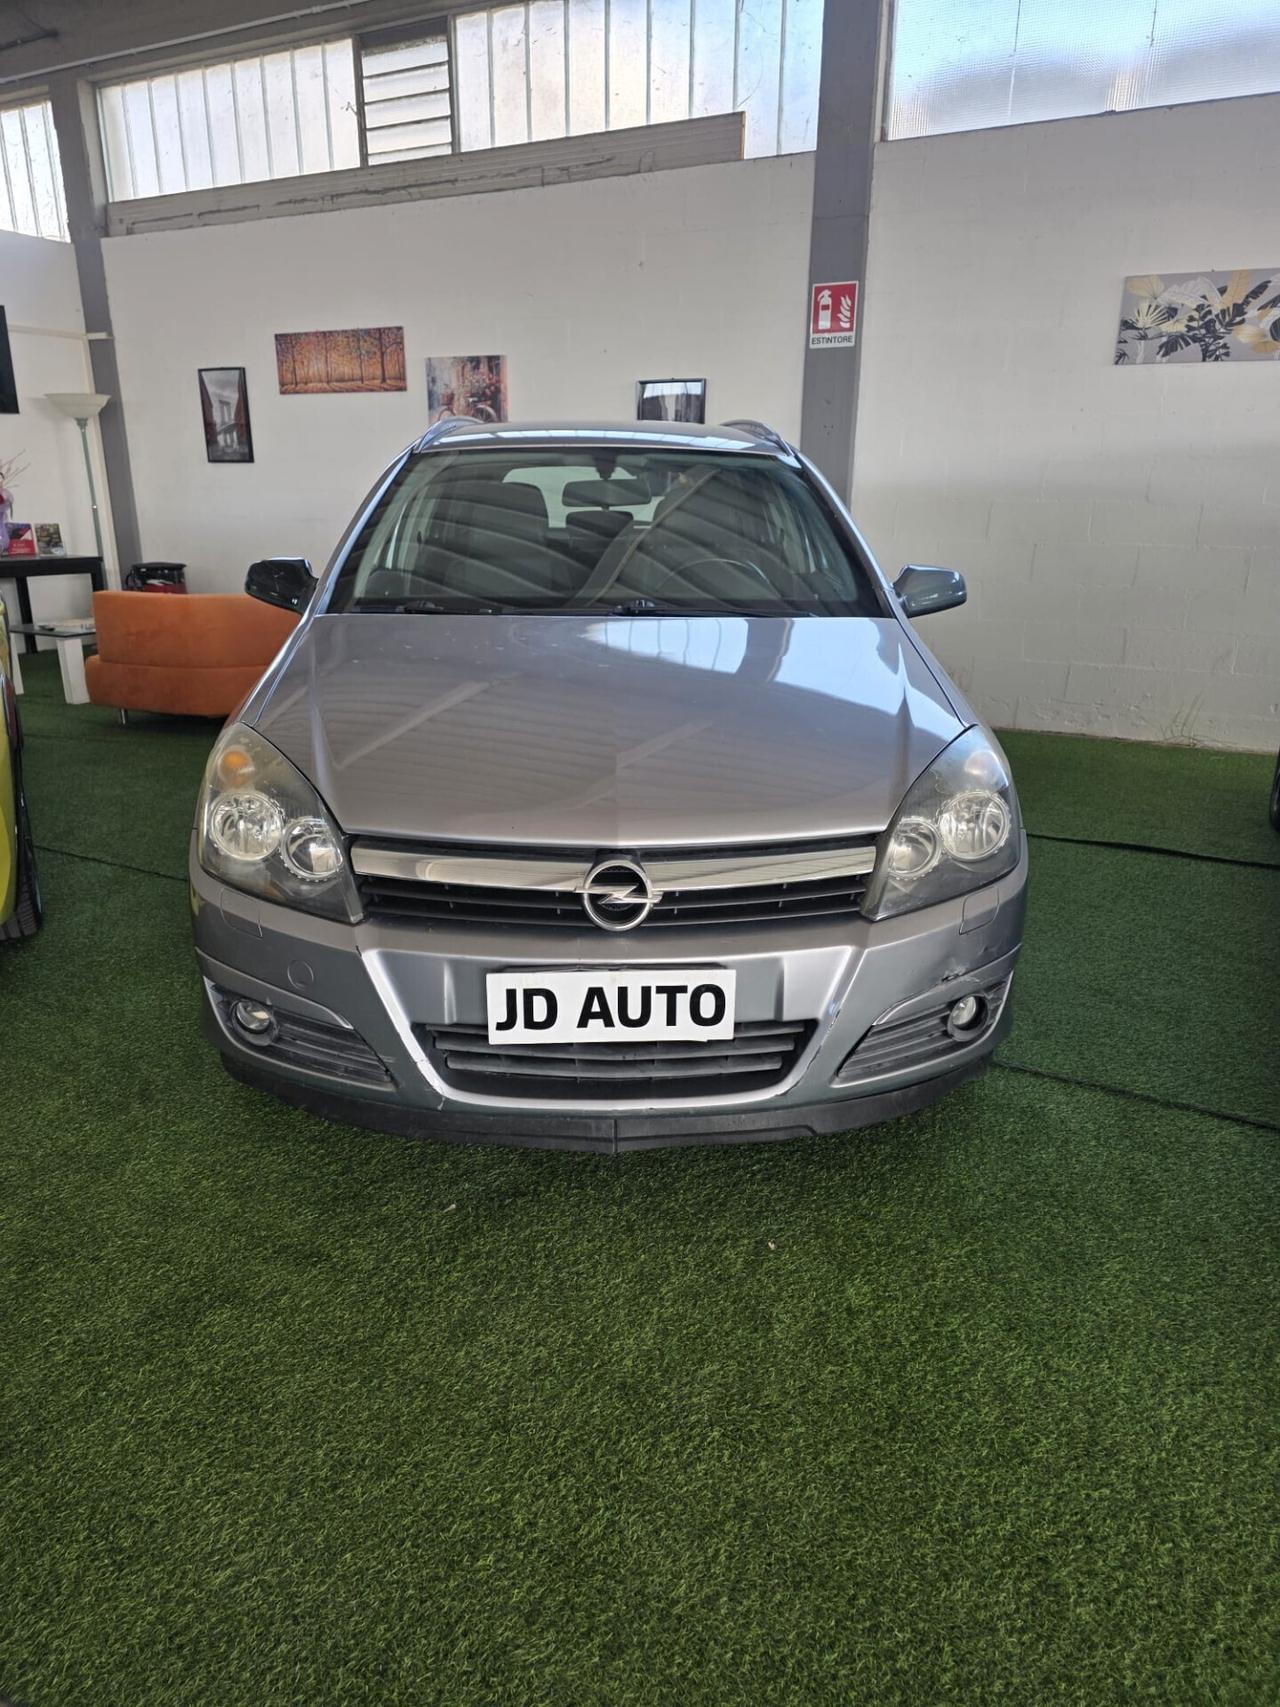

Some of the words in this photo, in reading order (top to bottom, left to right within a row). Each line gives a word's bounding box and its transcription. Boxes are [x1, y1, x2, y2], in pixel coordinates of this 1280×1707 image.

[811, 335, 853, 345] ESTINTORE
[495, 988, 558, 1031] JD
[576, 984, 726, 1029] AUTO
